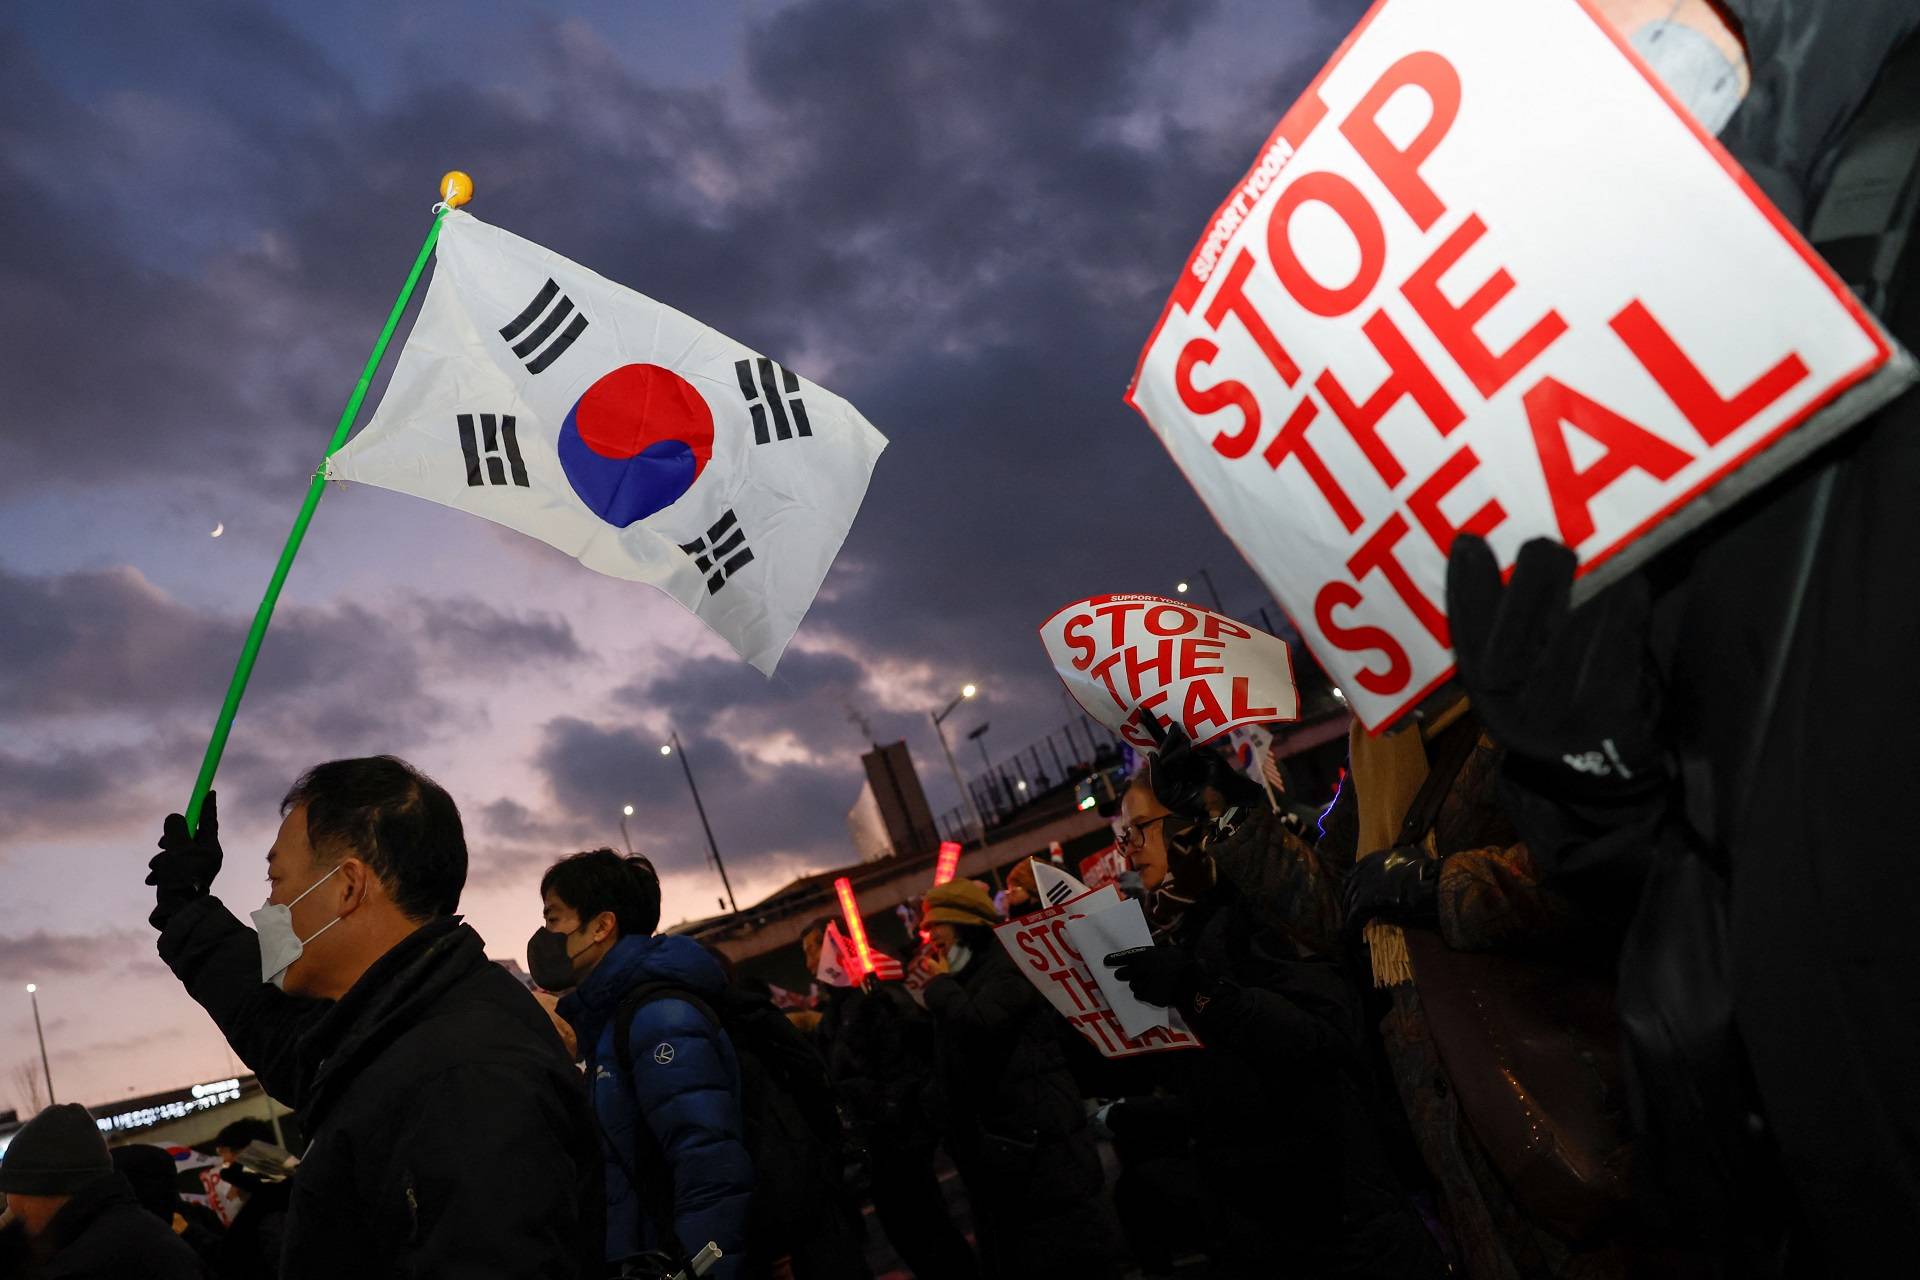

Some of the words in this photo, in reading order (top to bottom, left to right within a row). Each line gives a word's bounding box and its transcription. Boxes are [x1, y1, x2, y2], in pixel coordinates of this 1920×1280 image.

[1191, 191, 1249, 283] SUPPORT
[1242, 135, 1295, 201] YOON
[1174, 50, 1462, 460] STOP
[1263, 212, 1569, 534] THE
[1313, 297, 1811, 696] STEAL
[1063, 603, 1252, 671] STOP
[1110, 594, 1158, 602] SUPPORT
[1159, 597, 1188, 607] YOON
[1090, 638, 1226, 712] THE
[1015, 913, 1088, 972] STO
[1050, 963, 1101, 1012] TH
